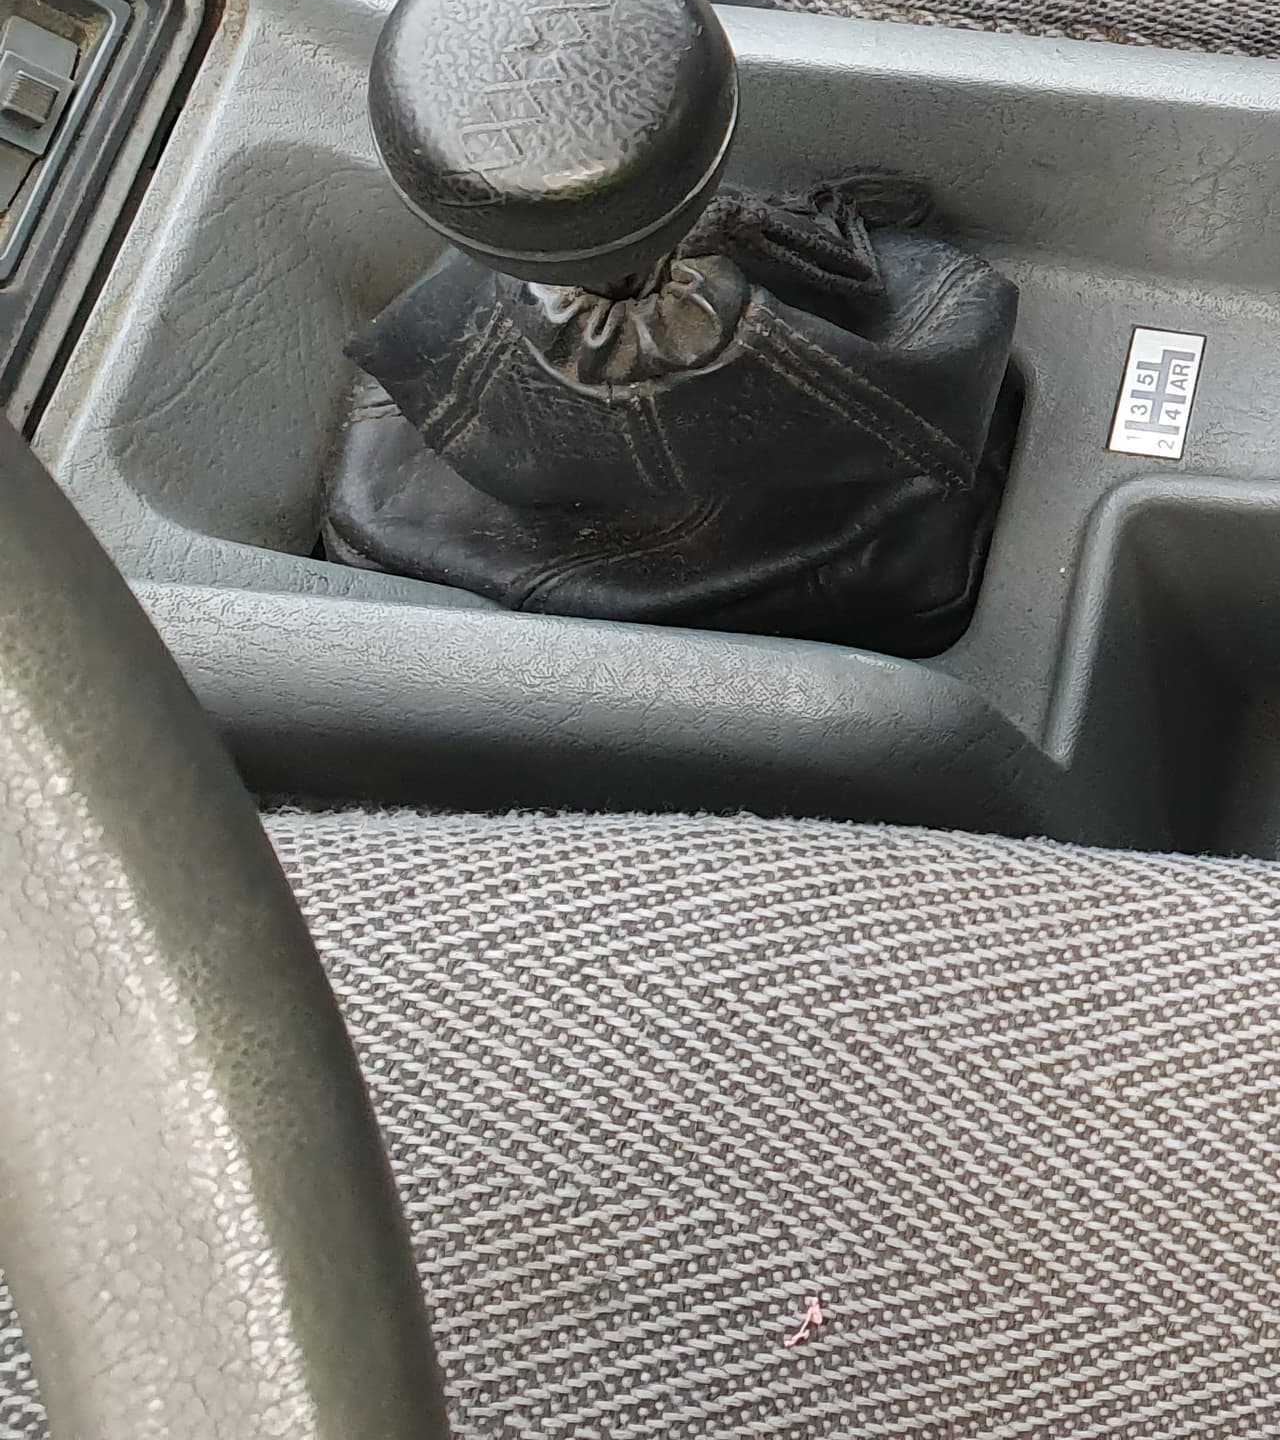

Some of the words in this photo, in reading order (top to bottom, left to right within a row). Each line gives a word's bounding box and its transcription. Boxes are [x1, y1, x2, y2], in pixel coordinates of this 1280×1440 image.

[1136, 373, 1154, 386] 5
[1170, 364, 1191, 391] AR
[1130, 404, 1148, 416] 3
[1165, 408, 1182, 421] 4
[1157, 439, 1175, 450] 2
